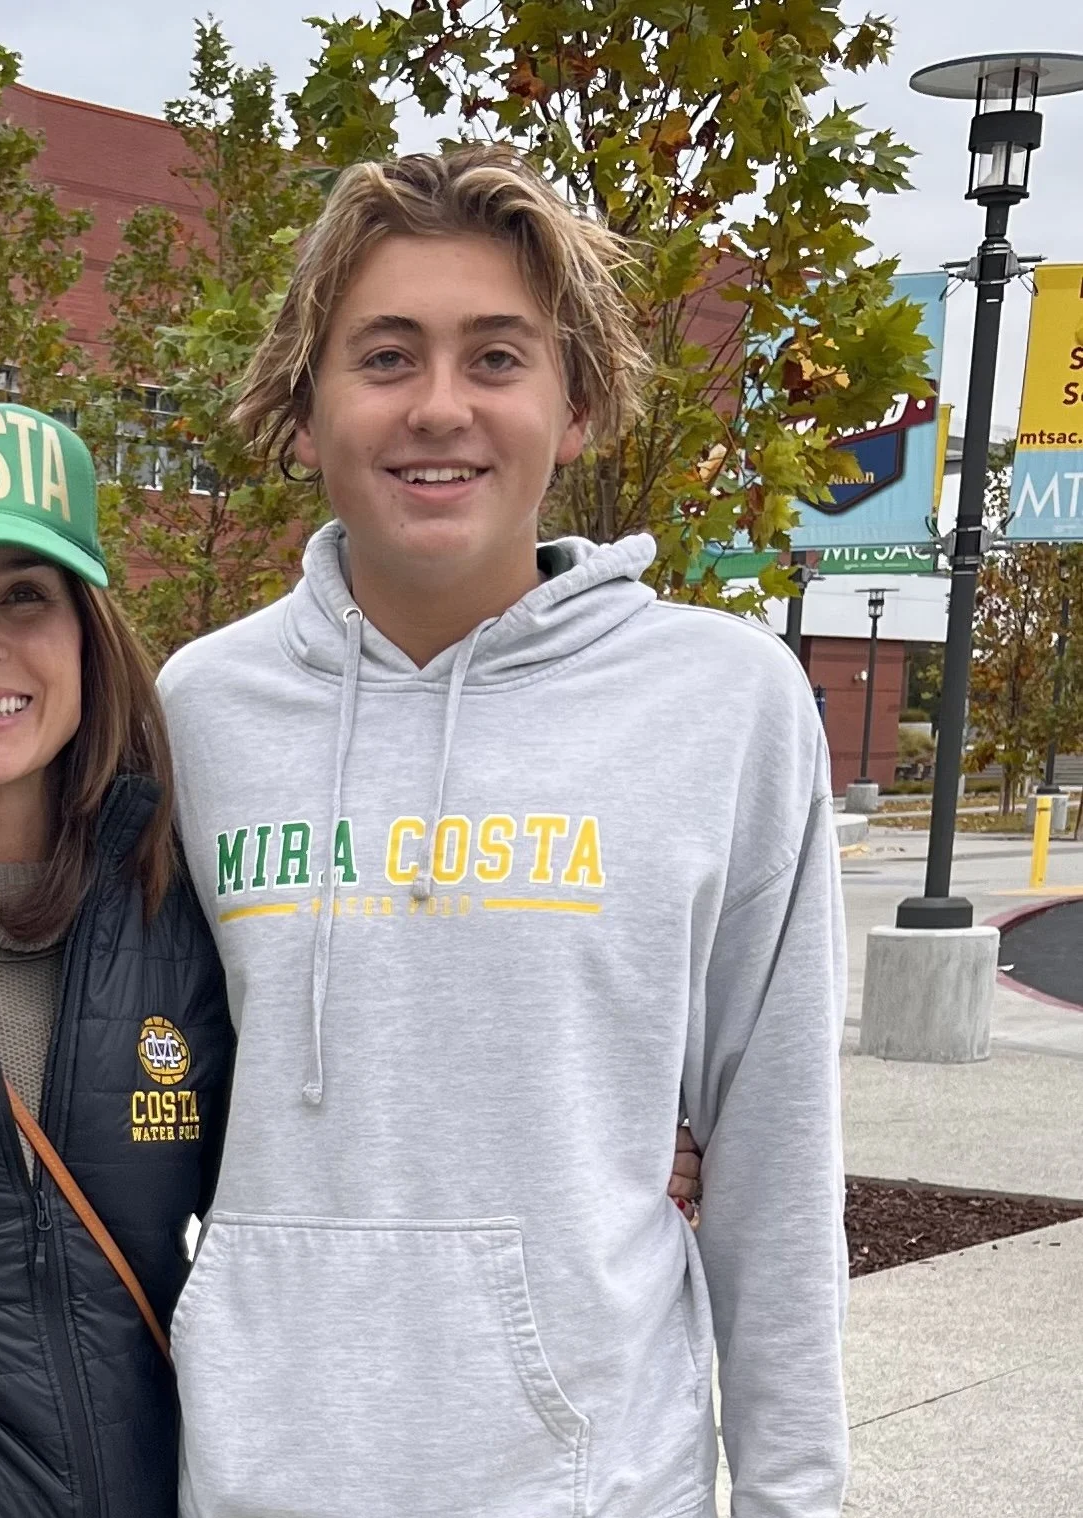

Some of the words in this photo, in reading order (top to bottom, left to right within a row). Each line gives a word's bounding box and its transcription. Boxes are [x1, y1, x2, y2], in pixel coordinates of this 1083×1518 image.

[1062, 381, 1083, 405] S
[1014, 471, 1083, 518] MT
[216, 816, 360, 896] MIRA
[385, 813, 606, 889] COSTA
[131, 1090, 200, 1124] COSTA
[131, 1126, 176, 1141] WATER
[178, 1124, 200, 1140] POLO
